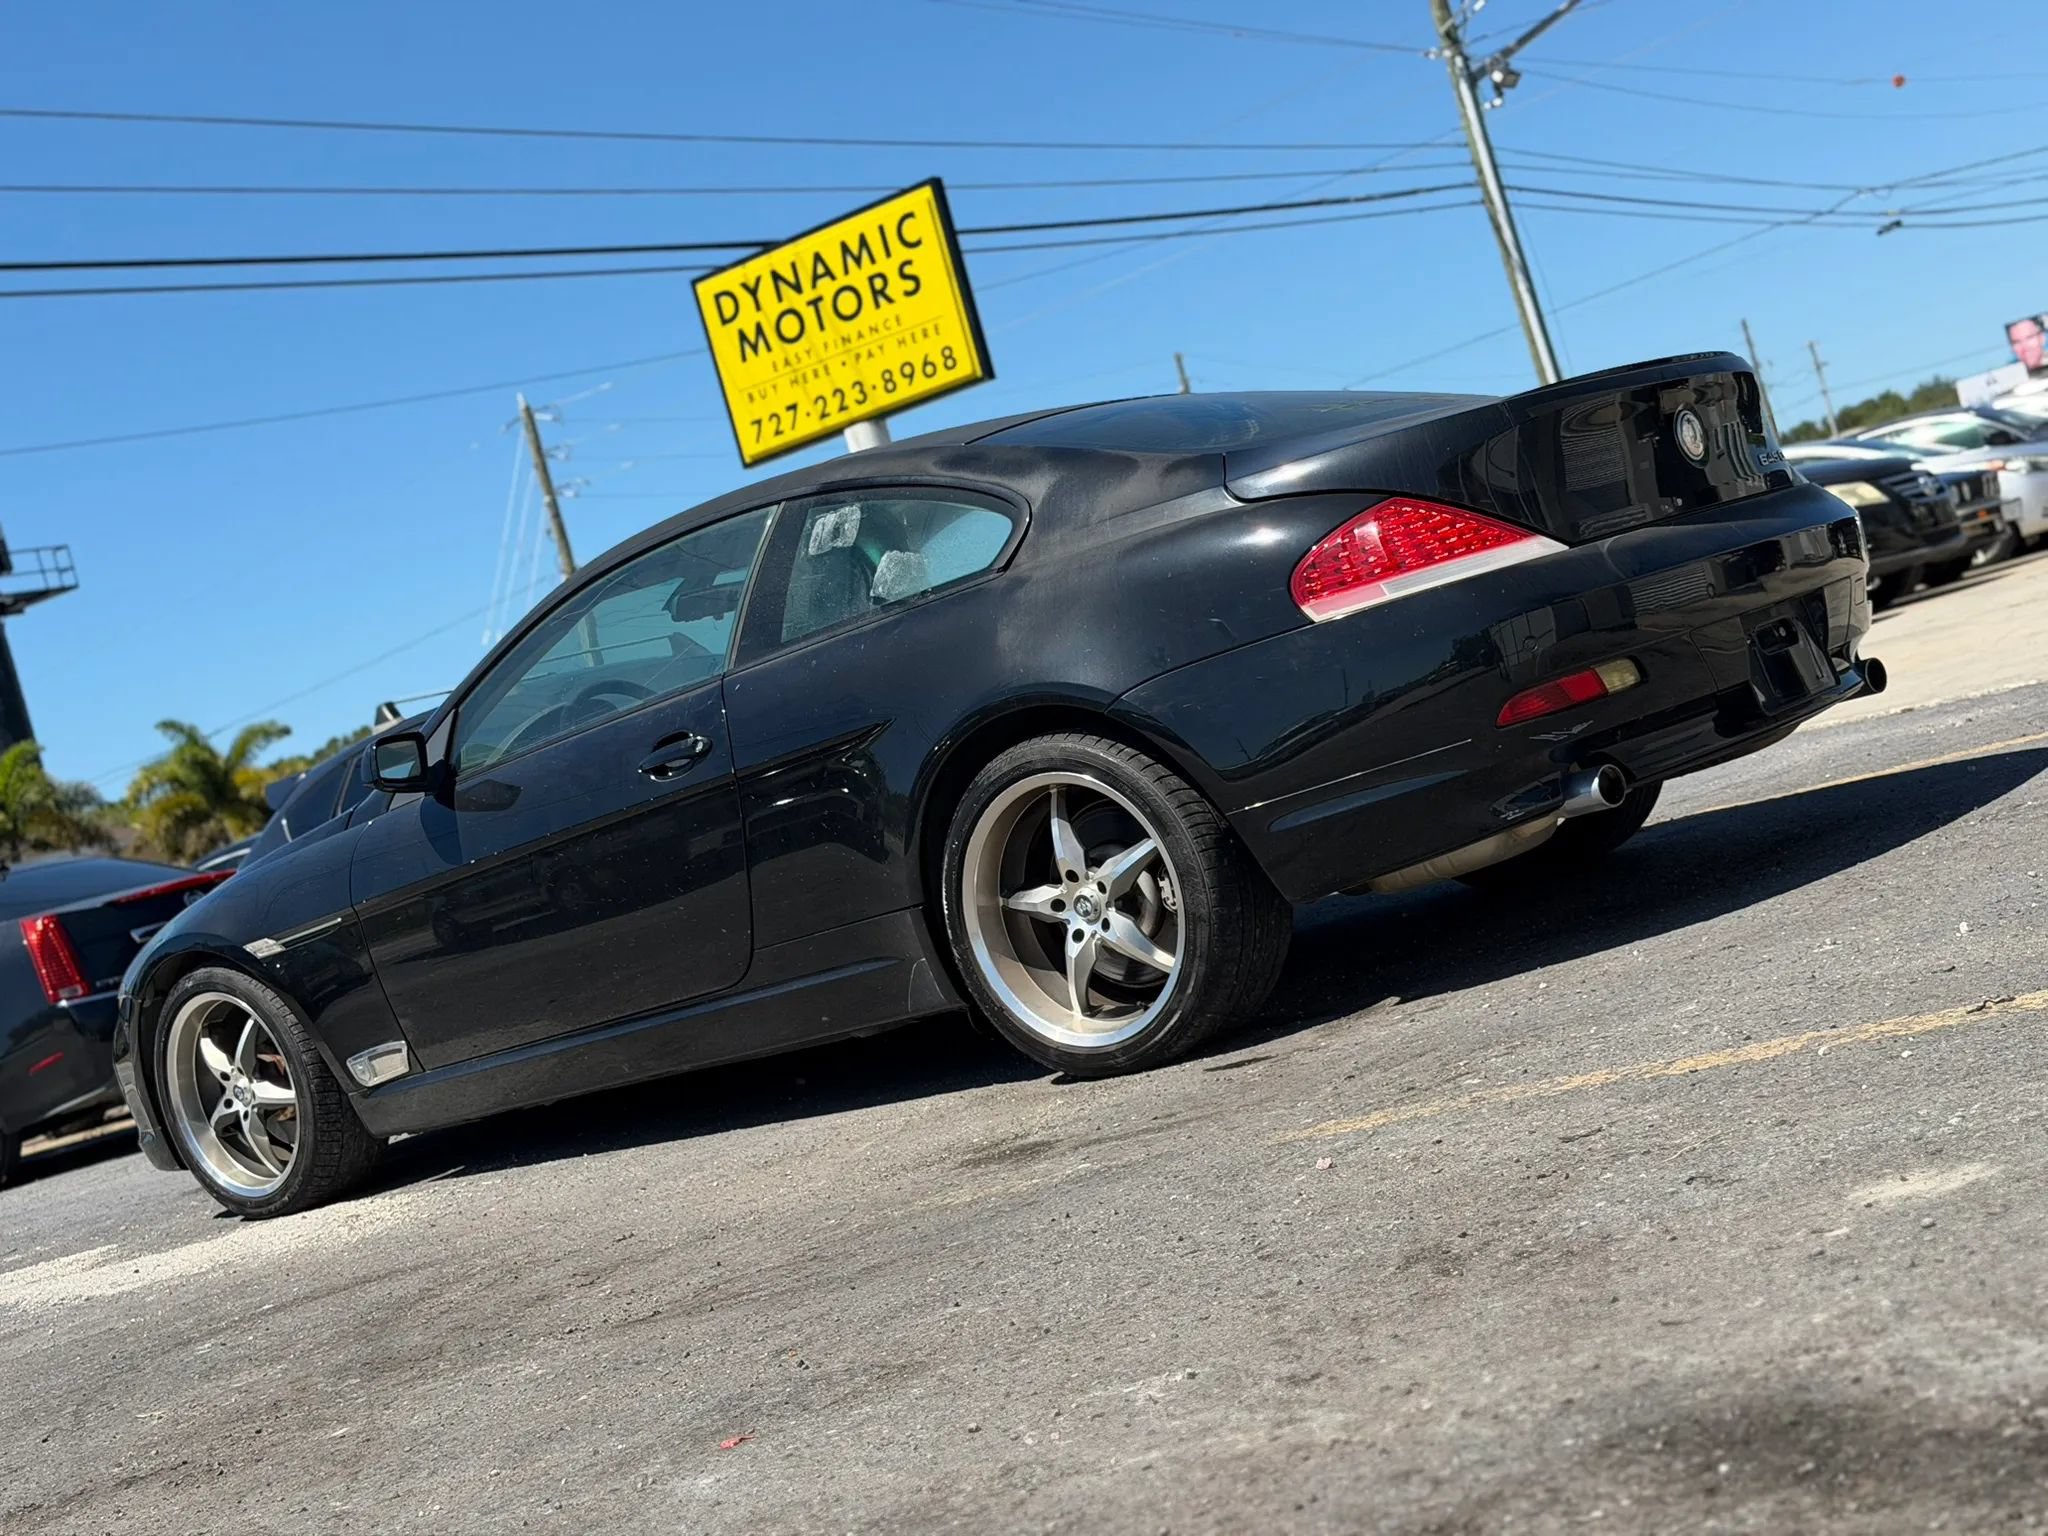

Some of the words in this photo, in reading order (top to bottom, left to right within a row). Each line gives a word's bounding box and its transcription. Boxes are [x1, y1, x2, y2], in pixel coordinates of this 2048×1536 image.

[714, 211, 922, 326] DYNAMIC
[737, 260, 922, 363] MOTORS
[747, 384, 779, 404] BUY
[789, 364, 831, 388] HERE
[854, 344, 885, 364] PAY
[896, 323, 941, 348] HERE
[772, 348, 812, 372] EASY
[824, 314, 902, 351] FINANCE
